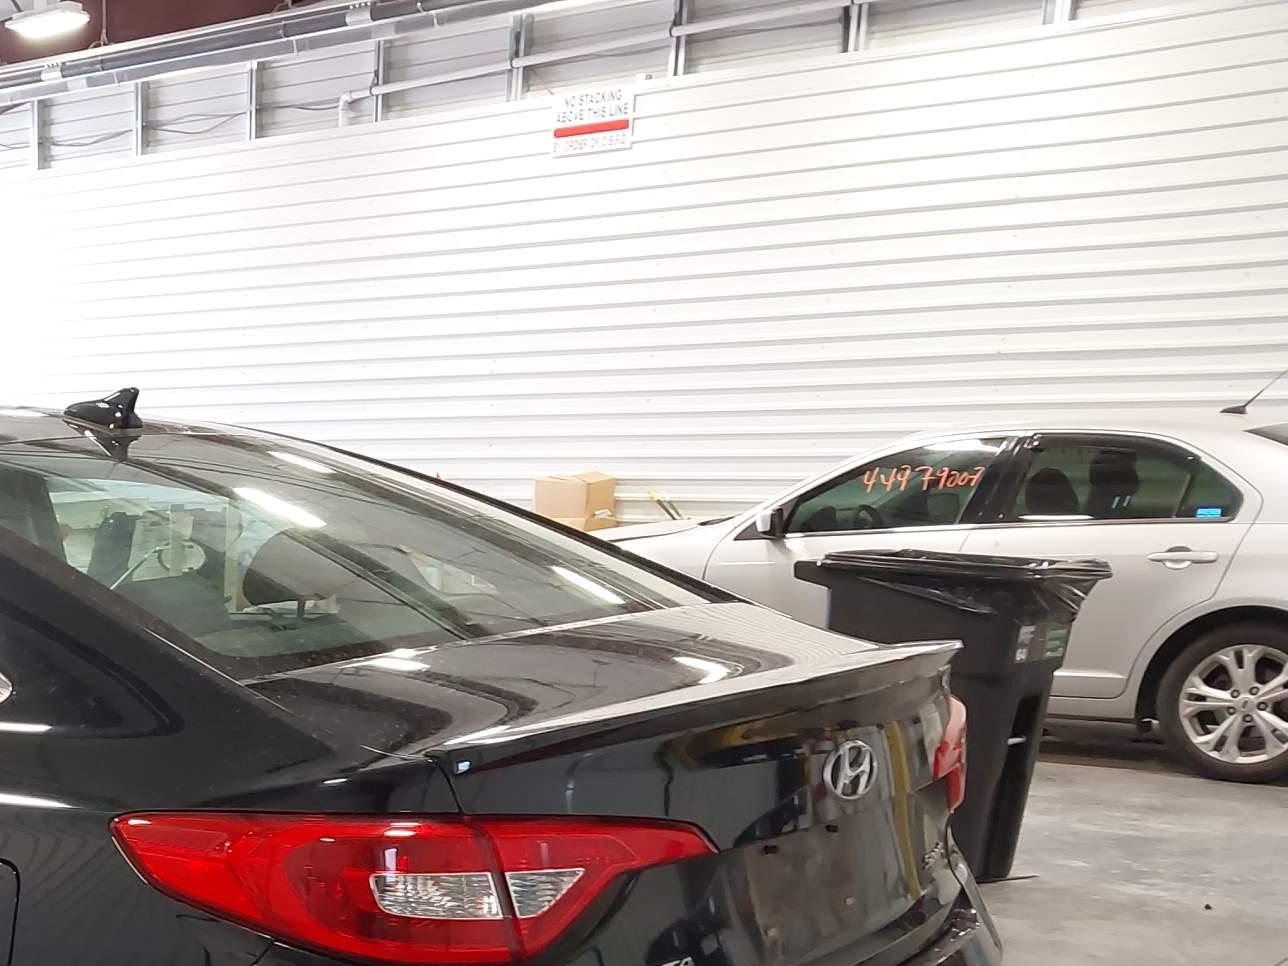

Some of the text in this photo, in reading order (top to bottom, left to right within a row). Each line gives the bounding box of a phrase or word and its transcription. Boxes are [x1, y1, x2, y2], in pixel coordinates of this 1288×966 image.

[564, 88, 623, 107] NO STACKING
[555, 101, 629, 123] ABOVE THIS LINE
